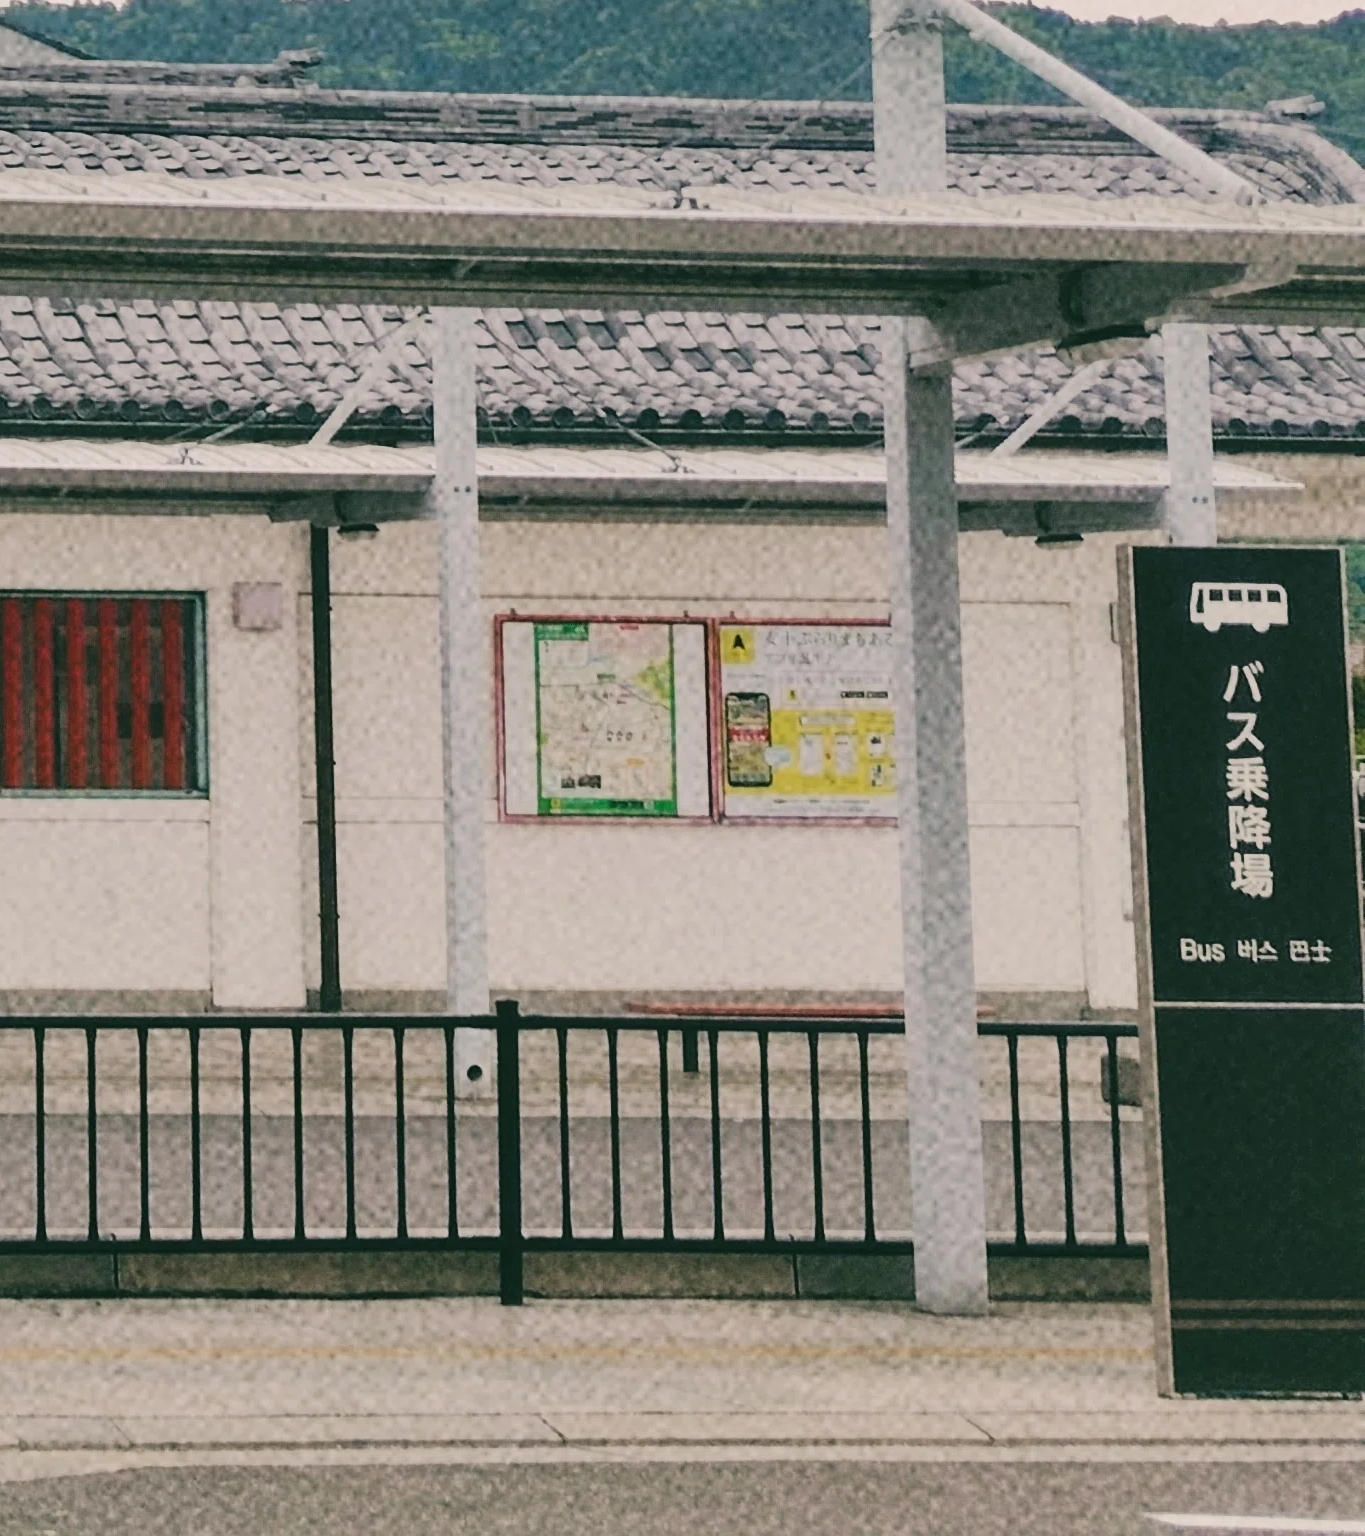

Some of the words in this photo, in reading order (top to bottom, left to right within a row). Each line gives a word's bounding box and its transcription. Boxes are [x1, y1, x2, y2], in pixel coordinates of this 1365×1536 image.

[1222, 660, 1274, 898] バス乗降場
[1180, 937, 1226, 963] Bus
[1237, 938, 1279, 963] 버스
[1289, 938, 1333, 963] 巴士
